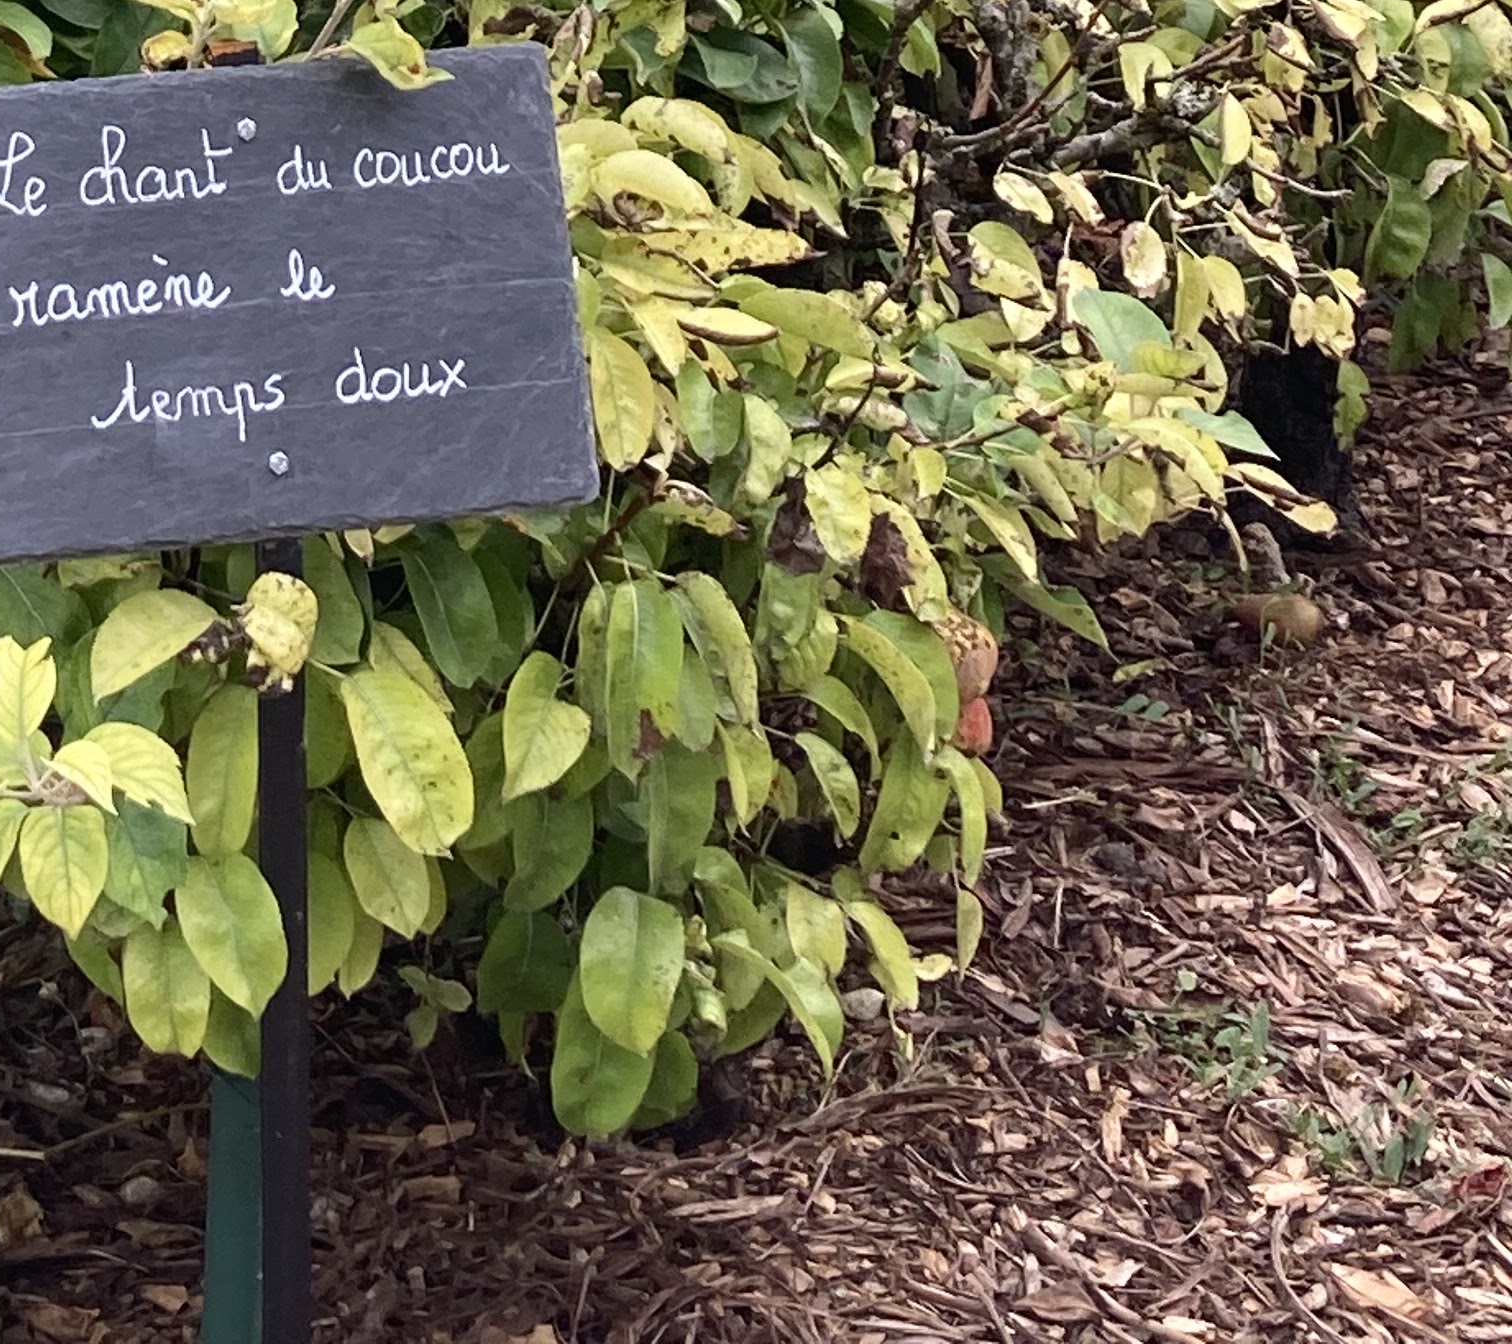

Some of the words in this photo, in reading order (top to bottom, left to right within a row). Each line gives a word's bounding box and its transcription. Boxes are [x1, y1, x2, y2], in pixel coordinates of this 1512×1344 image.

[80, 125, 232, 207] chant
[277, 144, 332, 196] du
[354, 141, 510, 191] coucou
[8, 254, 231, 327] ramène
[281, 249, 336, 300] le
[91, 361, 286, 442] temps
[336, 347, 468, 405] doux
